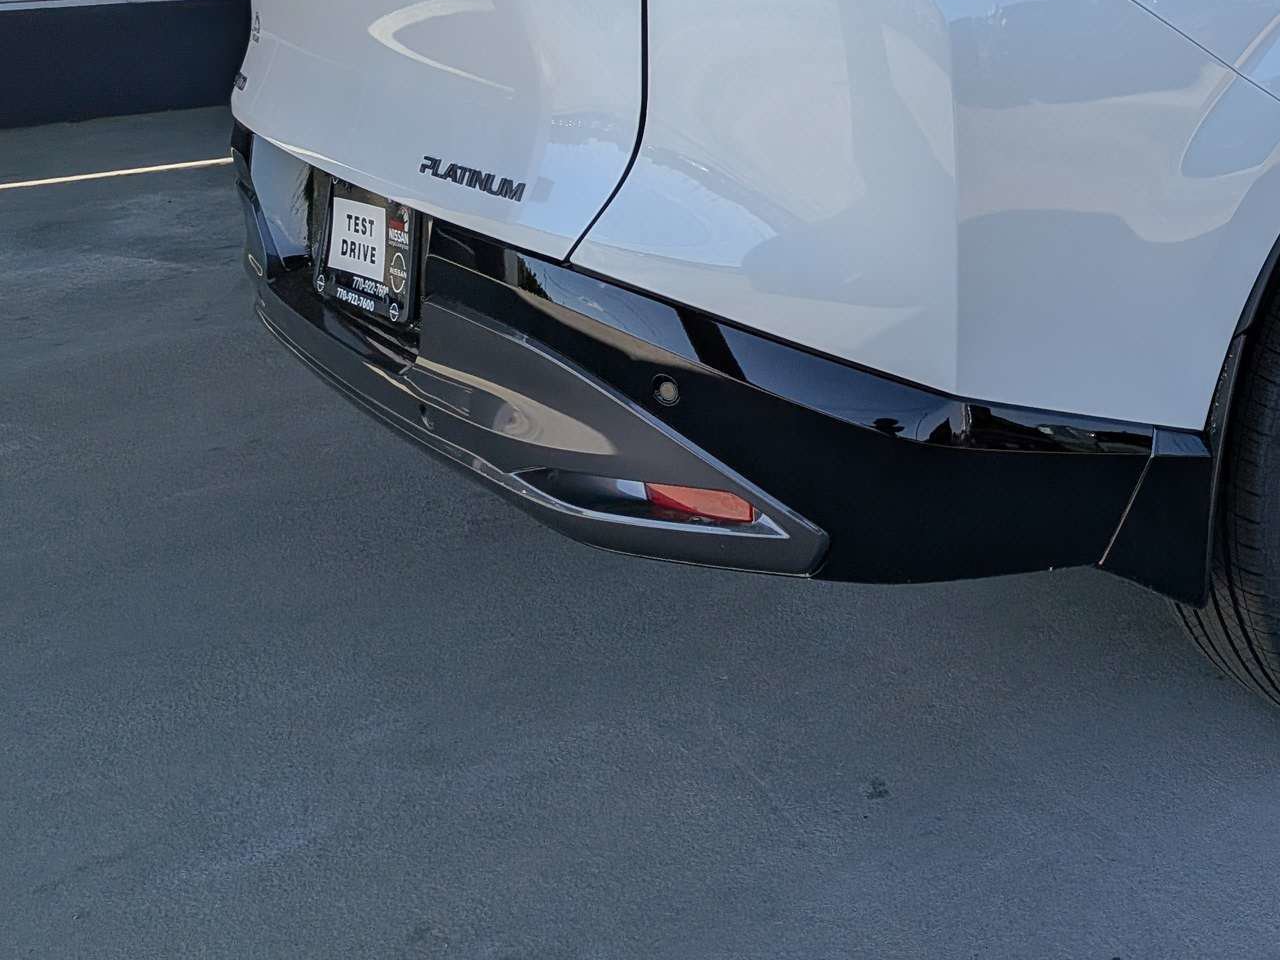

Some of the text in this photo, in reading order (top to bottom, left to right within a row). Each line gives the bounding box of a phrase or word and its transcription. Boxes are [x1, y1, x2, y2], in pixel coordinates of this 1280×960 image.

[419, 155, 527, 202] PLATINUM
[346, 214, 375, 237] TEST
[388, 227, 409, 245] NISSAN
[341, 238, 377, 265] DRIVE
[389, 267, 407, 280] NISSAN
[336, 287, 375, 312] 770-922-7600
